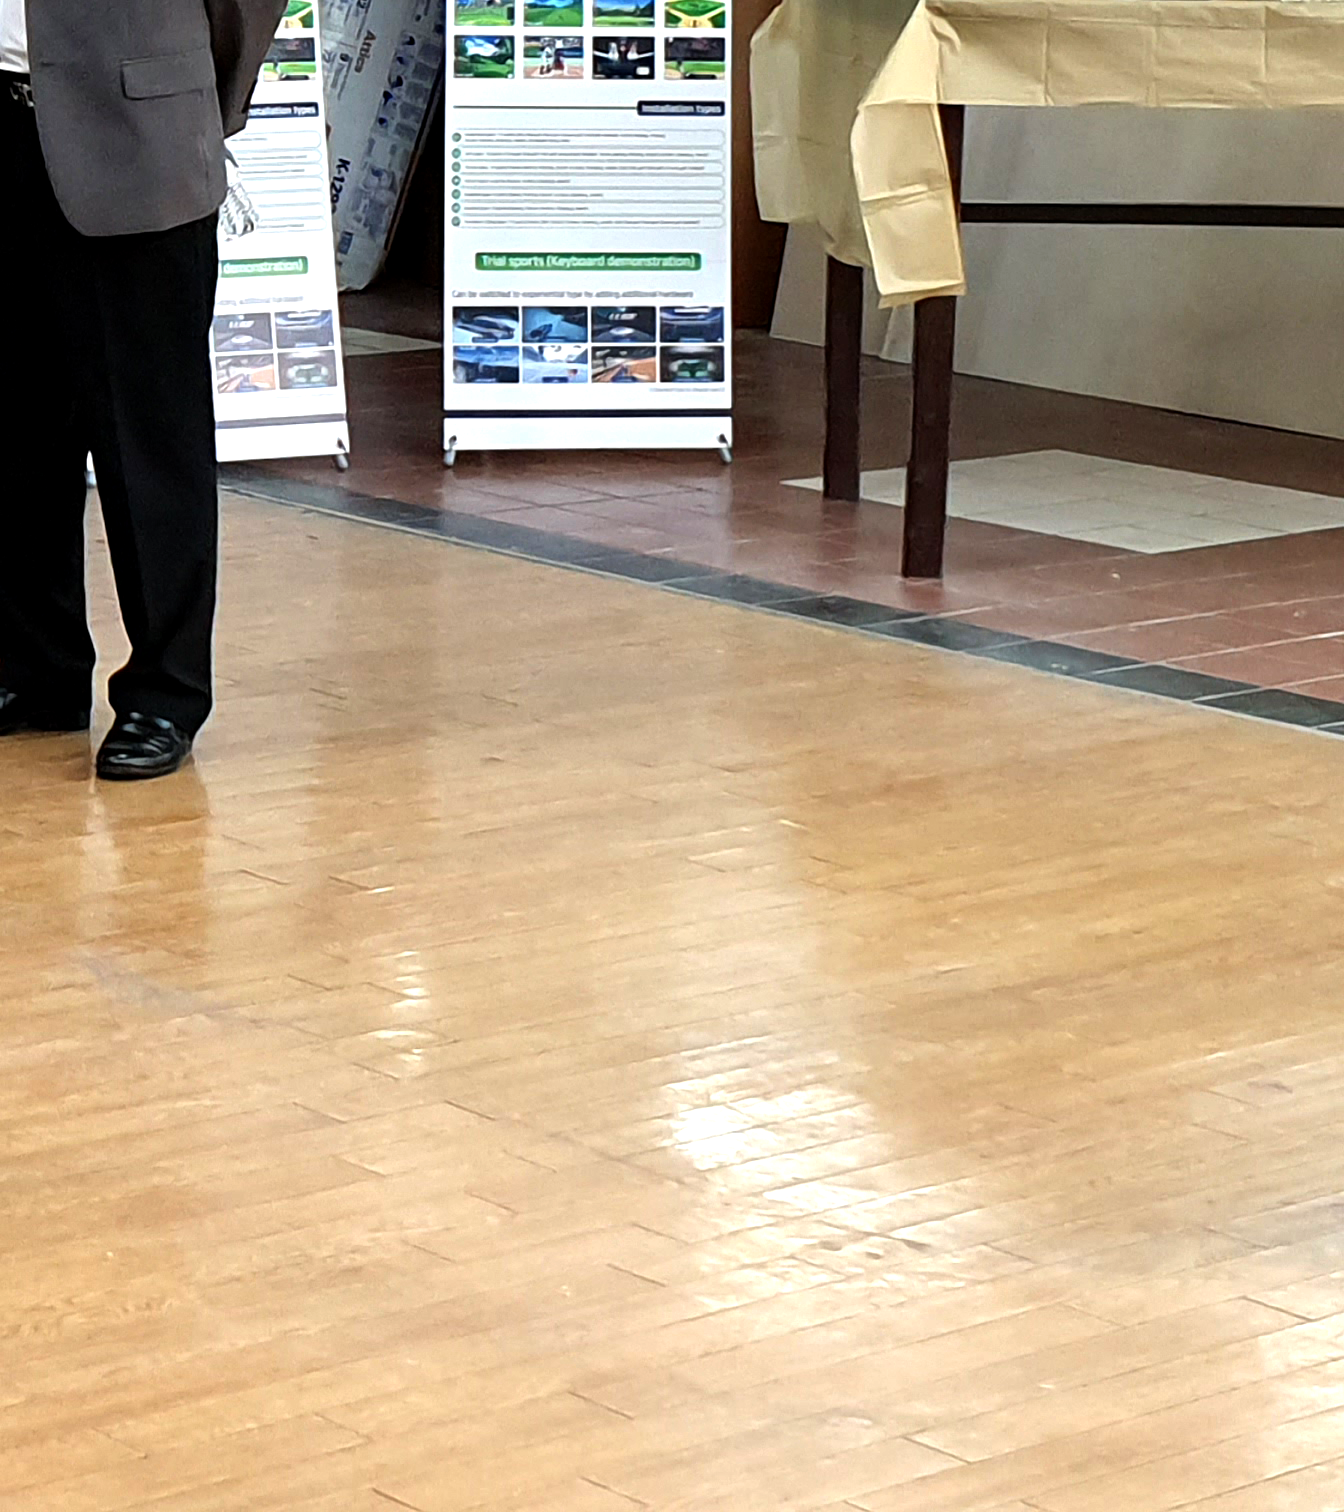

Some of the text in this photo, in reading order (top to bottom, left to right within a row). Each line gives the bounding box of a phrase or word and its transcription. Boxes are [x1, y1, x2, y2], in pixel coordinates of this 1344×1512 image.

[481, 254, 696, 269] Trial sports (Keyboard demonstration)
